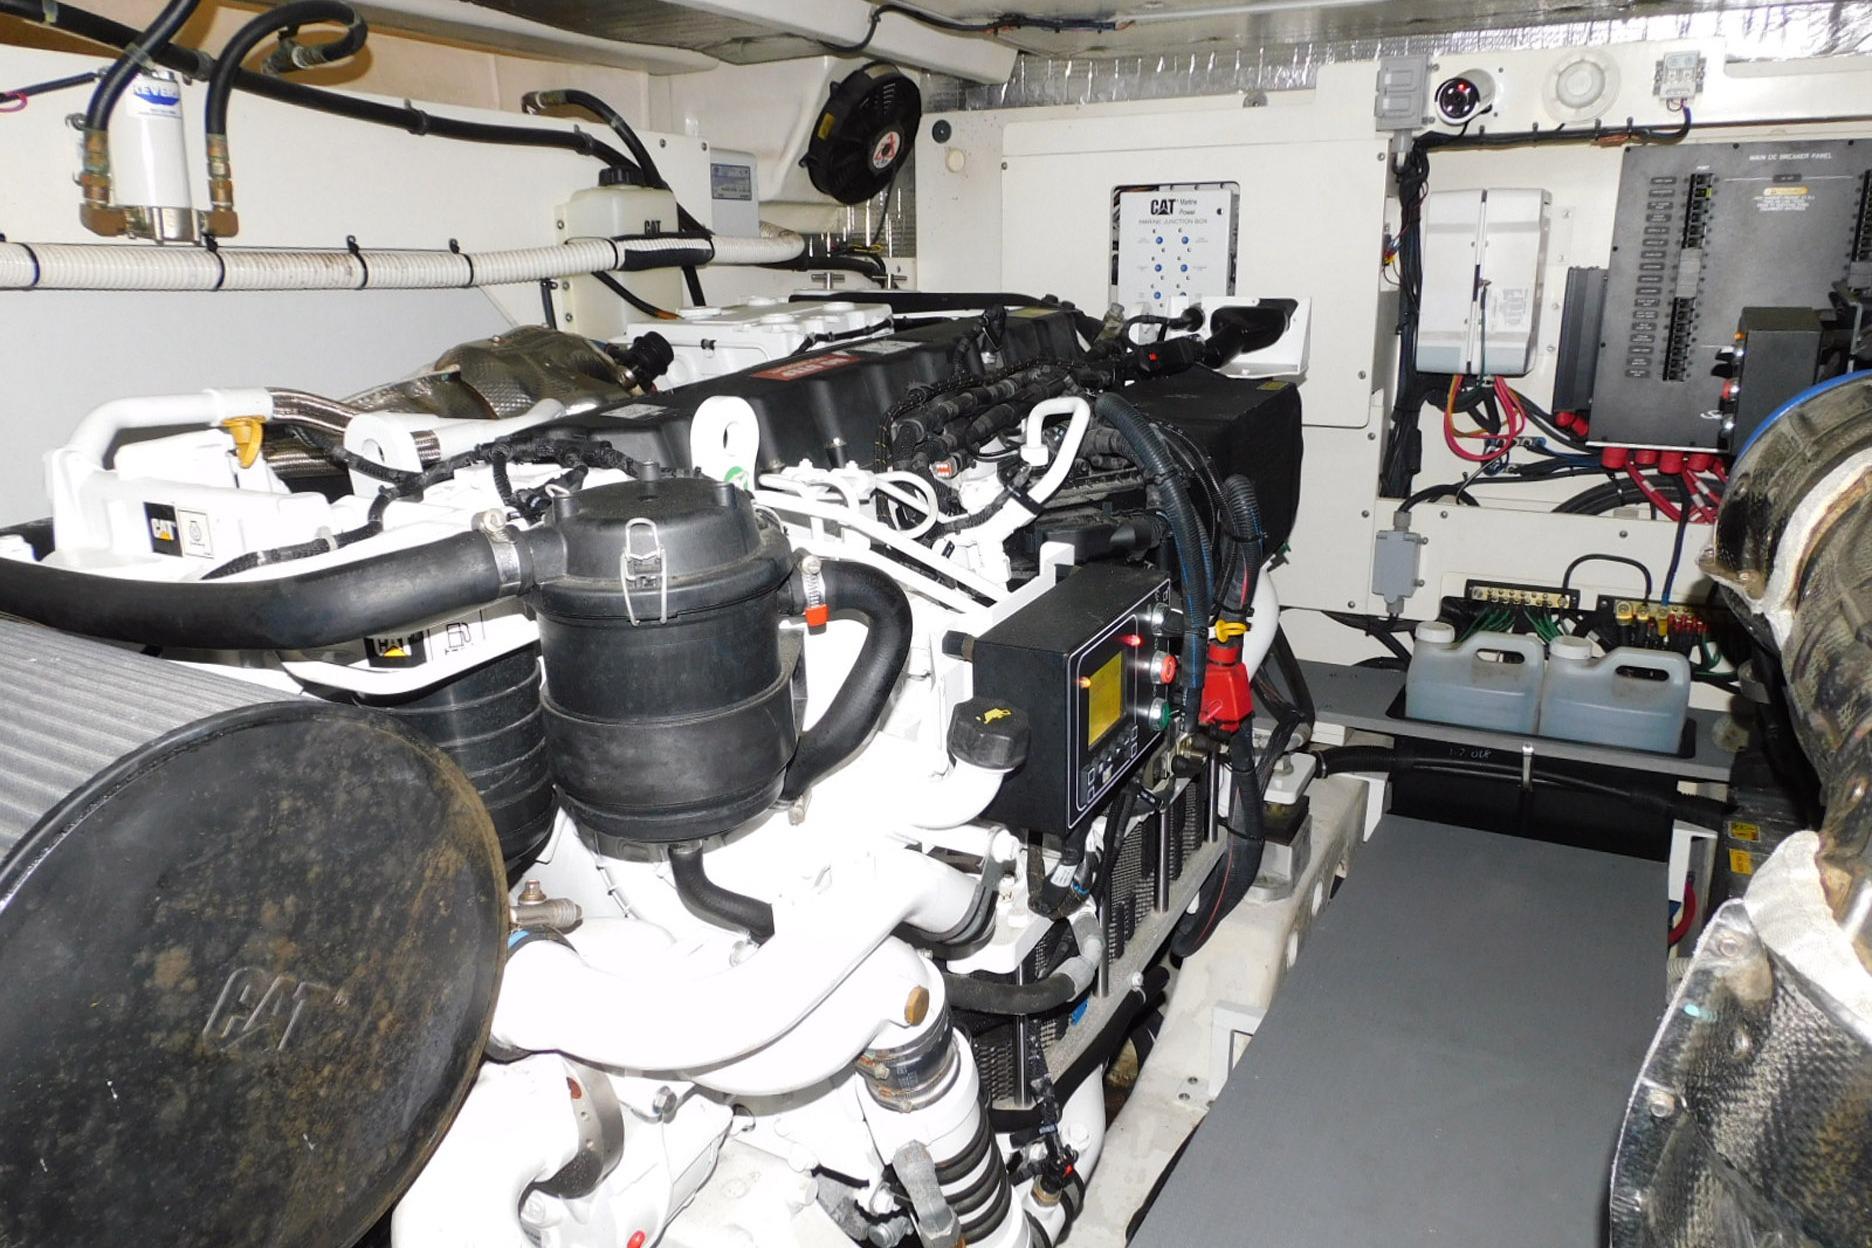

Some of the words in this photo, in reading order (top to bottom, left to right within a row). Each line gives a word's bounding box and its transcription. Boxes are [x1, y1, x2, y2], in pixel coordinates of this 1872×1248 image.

[1768, 153, 1777, 161] DC
[1810, 152, 1832, 160] PANEL
[1150, 199, 1176, 215] CAT
[644, 220, 661, 235] CAT
[150, 518, 177, 541] CAT
[200, 965, 332, 1052] CAT
